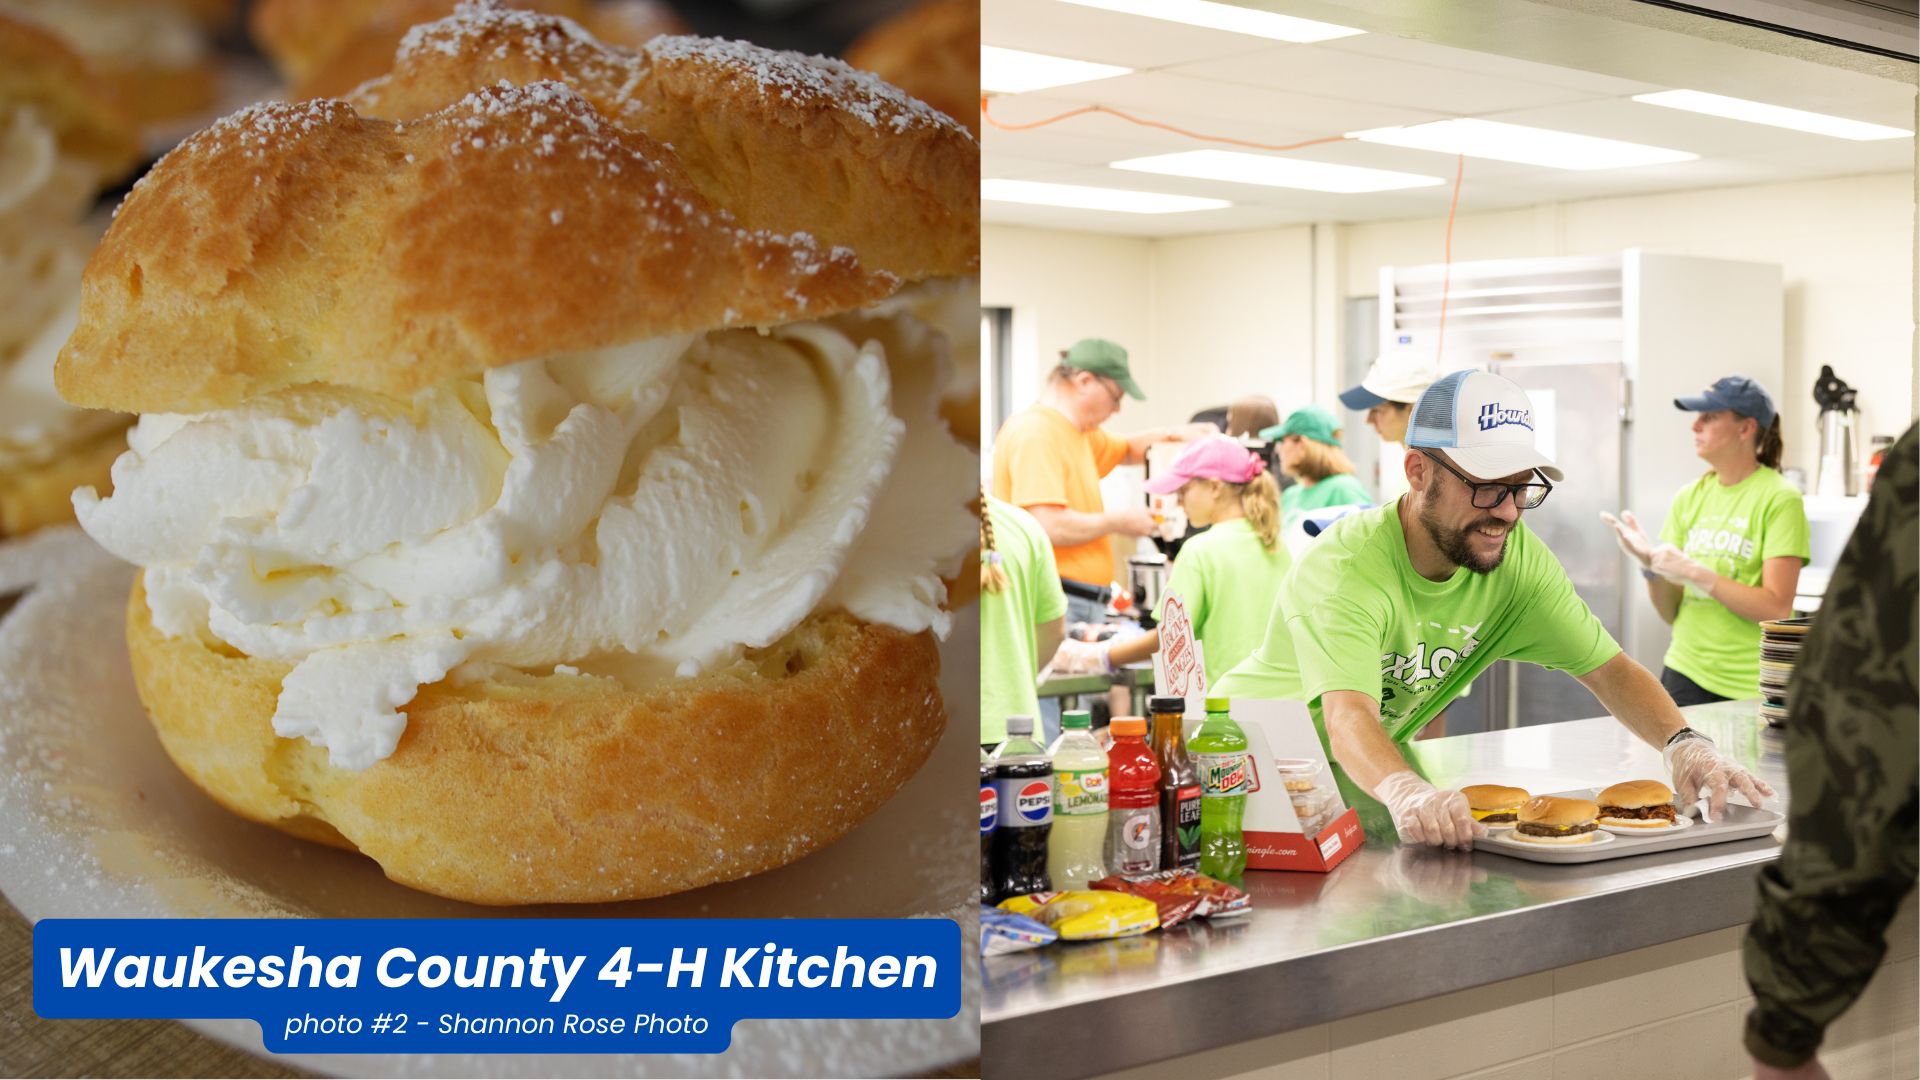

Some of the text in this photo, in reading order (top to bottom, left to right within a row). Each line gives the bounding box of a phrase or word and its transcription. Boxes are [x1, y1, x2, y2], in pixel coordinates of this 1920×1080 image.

[1180, 799, 1201, 813] PURE
[1180, 810, 1201, 823] LEAF
[1123, 814, 1150, 850] G
[1245, 844, 1297, 858] ringle.com
